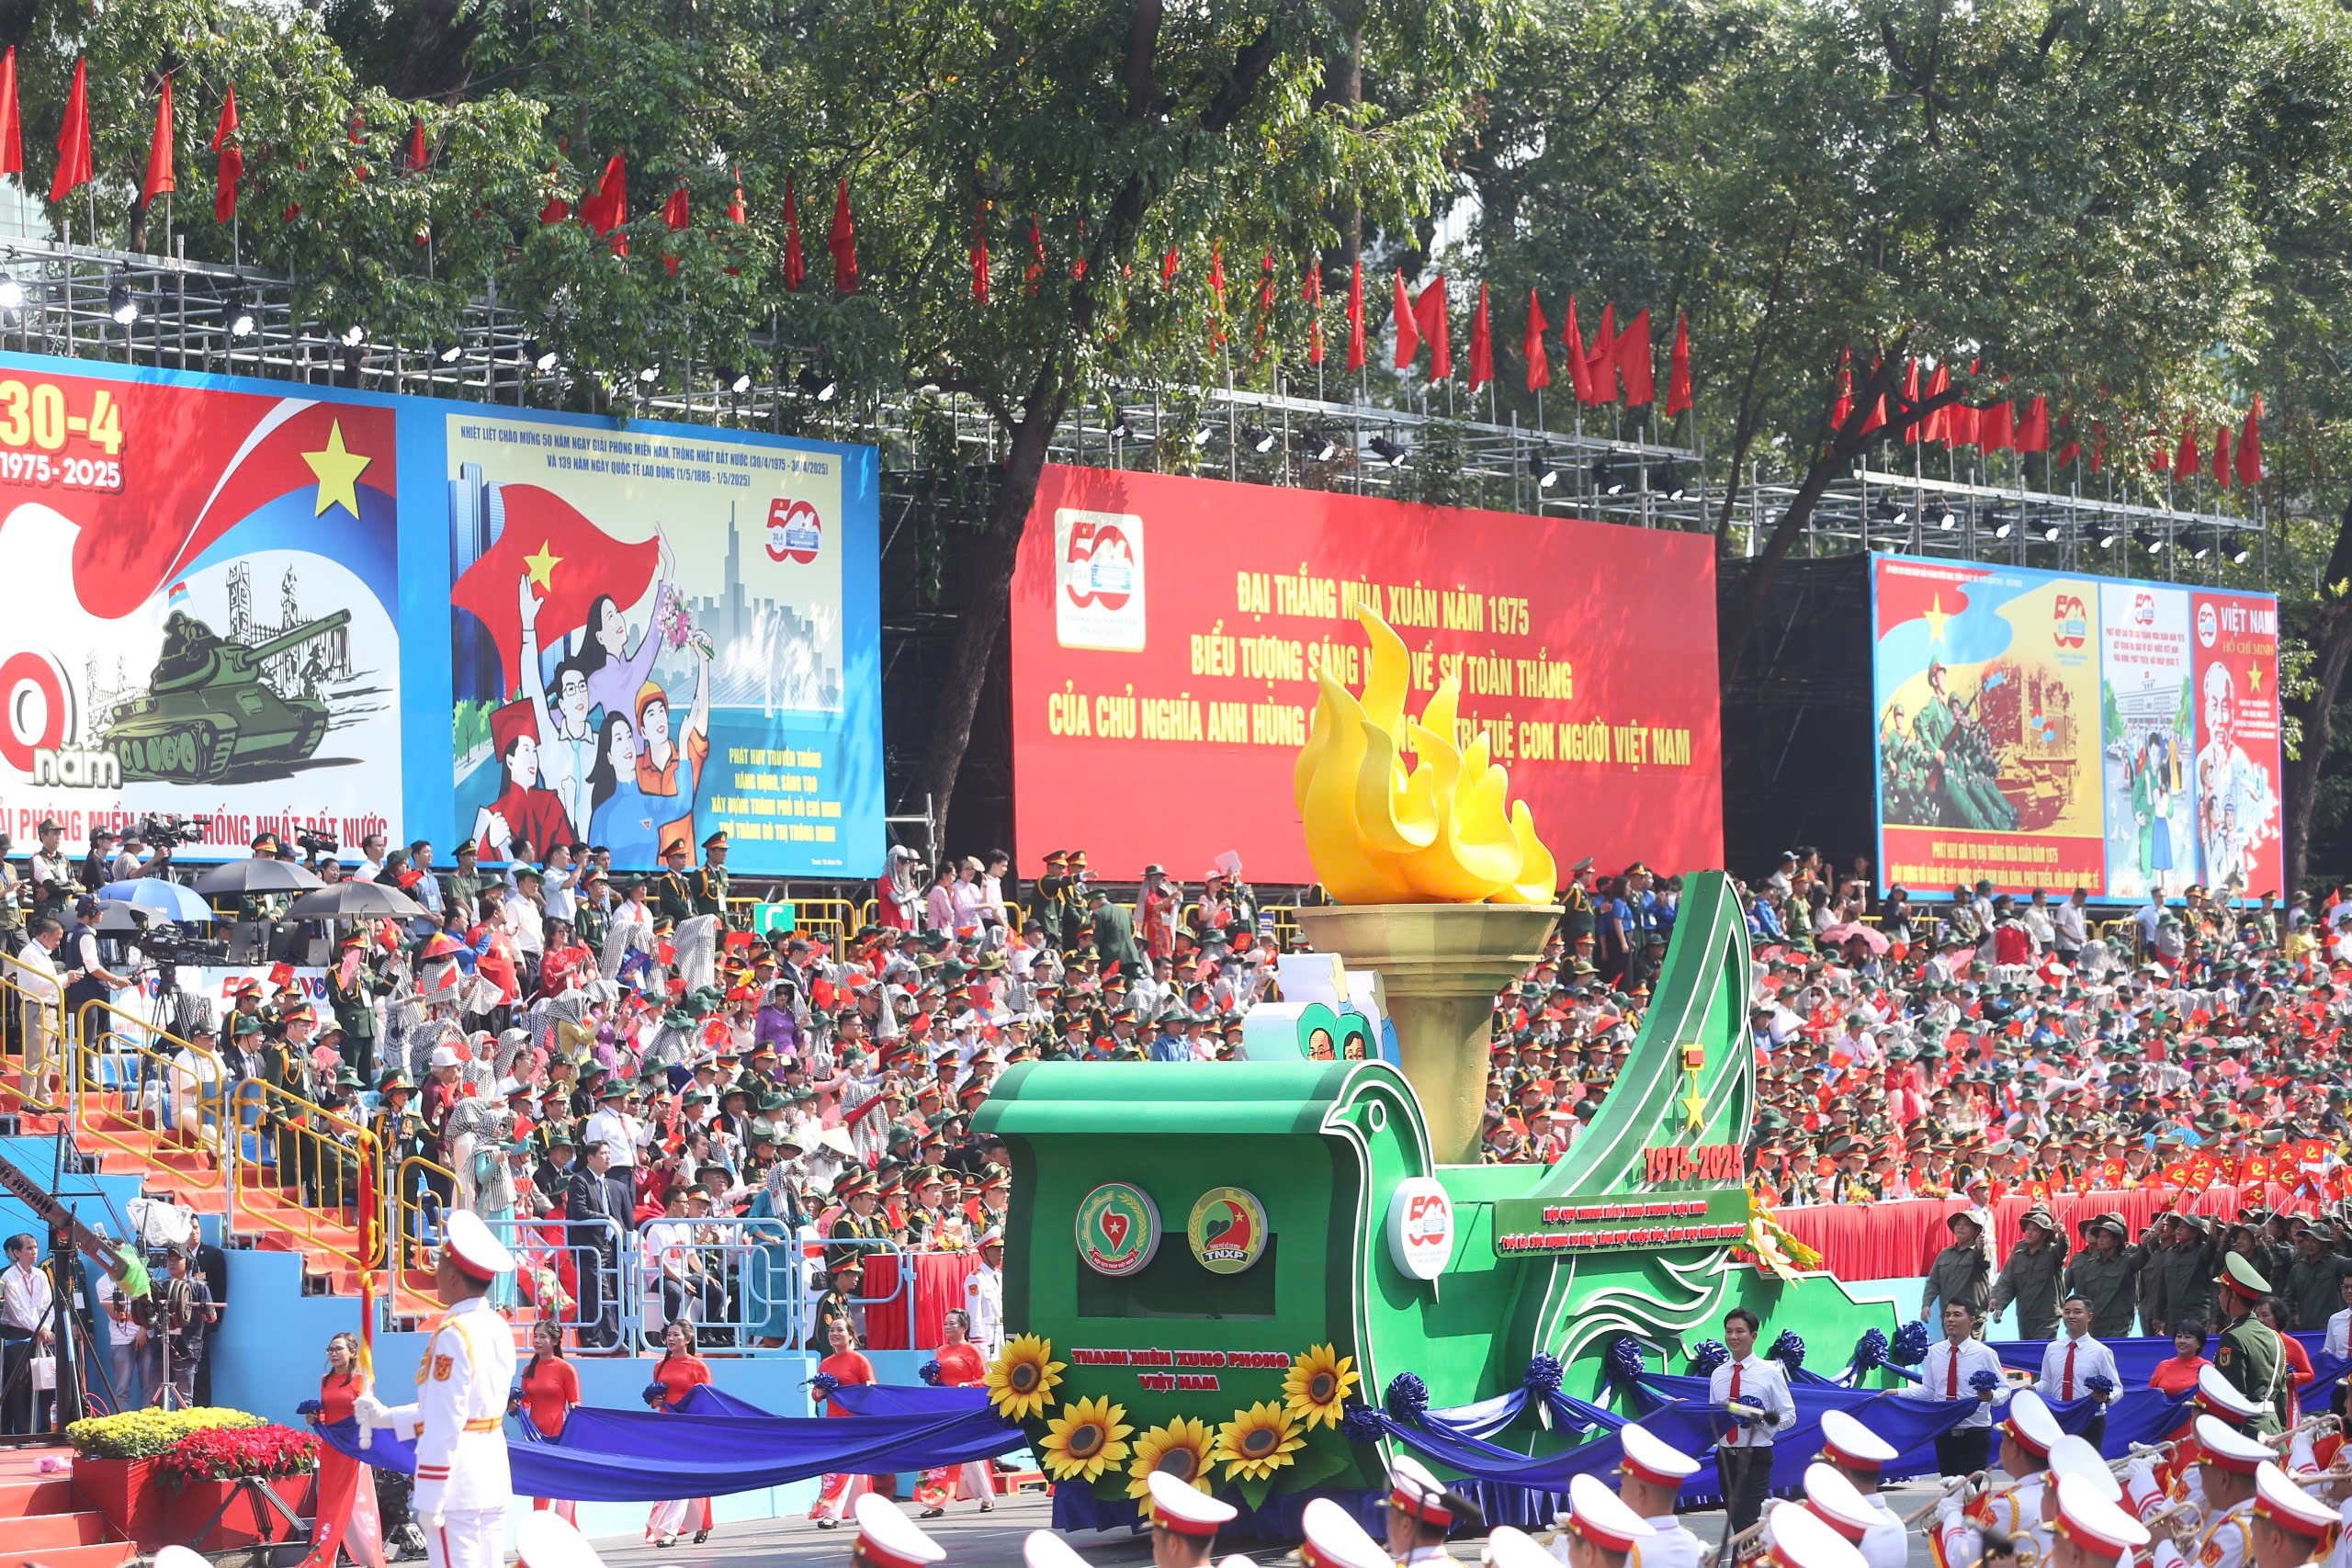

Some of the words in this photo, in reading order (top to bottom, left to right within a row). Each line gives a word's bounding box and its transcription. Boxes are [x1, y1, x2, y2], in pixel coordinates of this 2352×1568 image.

[0, 379, 123, 456] 30-4
[461, 424, 481, 441] NHIỆT
[483, 428, 496, 445] LIỆT
[499, 429, 517, 443] CHÀO
[520, 431, 541, 446] MỪNG
[542, 434, 552, 447] 50
[730, 451, 748, 467] NƯỚC
[750, 455, 786, 471] (30/4/1975
[547, 454, 557, 468] VÀ
[559, 456, 571, 469] 139
[642, 464, 654, 478] LAO
[656, 465, 675, 481] ĐỘNG
[676, 468, 710, 483] (1/5/1886
[717, 471, 751, 487] 1/5/2025)
[1237, 570, 1271, 623] ĐẠI
[1274, 561, 1338, 620] THẮNG
[1388, 580, 1439, 628] XUÂN
[1442, 583, 1484, 632] NĂM
[1488, 597, 1530, 636] 1975
[2220, 601, 2247, 637] VIỆT
[2249, 609, 2276, 635] NAM
[1191, 619, 1236, 677] BIỂU
[1240, 635, 1304, 689] TƯỢNG
[1307, 635, 1359, 686] SÁNG
[1411, 639, 1434, 692] VỀ
[1467, 649, 1513, 696] TOÀN
[1517, 647, 1573, 700] THẮNG
[1048, 679, 1091, 737] CỦA
[1096, 682, 1136, 739] CHỦ
[1142, 692, 1204, 742] NGHĨA
[1207, 702, 1250, 743] ANH
[1253, 696, 1306, 747] HÙNG
[1519, 720, 1555, 761] CON
[1558, 716, 1611, 763] NGƯỜI
[1613, 719, 1648, 773] VIỆT
[1653, 728, 1691, 766] NAM
[33, 742, 121, 787] năm
[750, 749, 765, 765] HUY
[193, 803, 251, 846] THỐNG
[343, 811, 388, 849] NƯỚC
[1645, 1144, 1743, 1182] 1975-2025
[1205, 1249, 1244, 1260] TNXP
[1071, 1348, 1130, 1366] THANH
[1130, 1347, 1173, 1367] NIÊN
[1174, 1349, 1227, 1368] XUNG
[1227, 1350, 1291, 1369] PHONG
[1137, 1371, 1176, 1393] VIỆT
[1177, 1374, 1221, 1391] NAM
